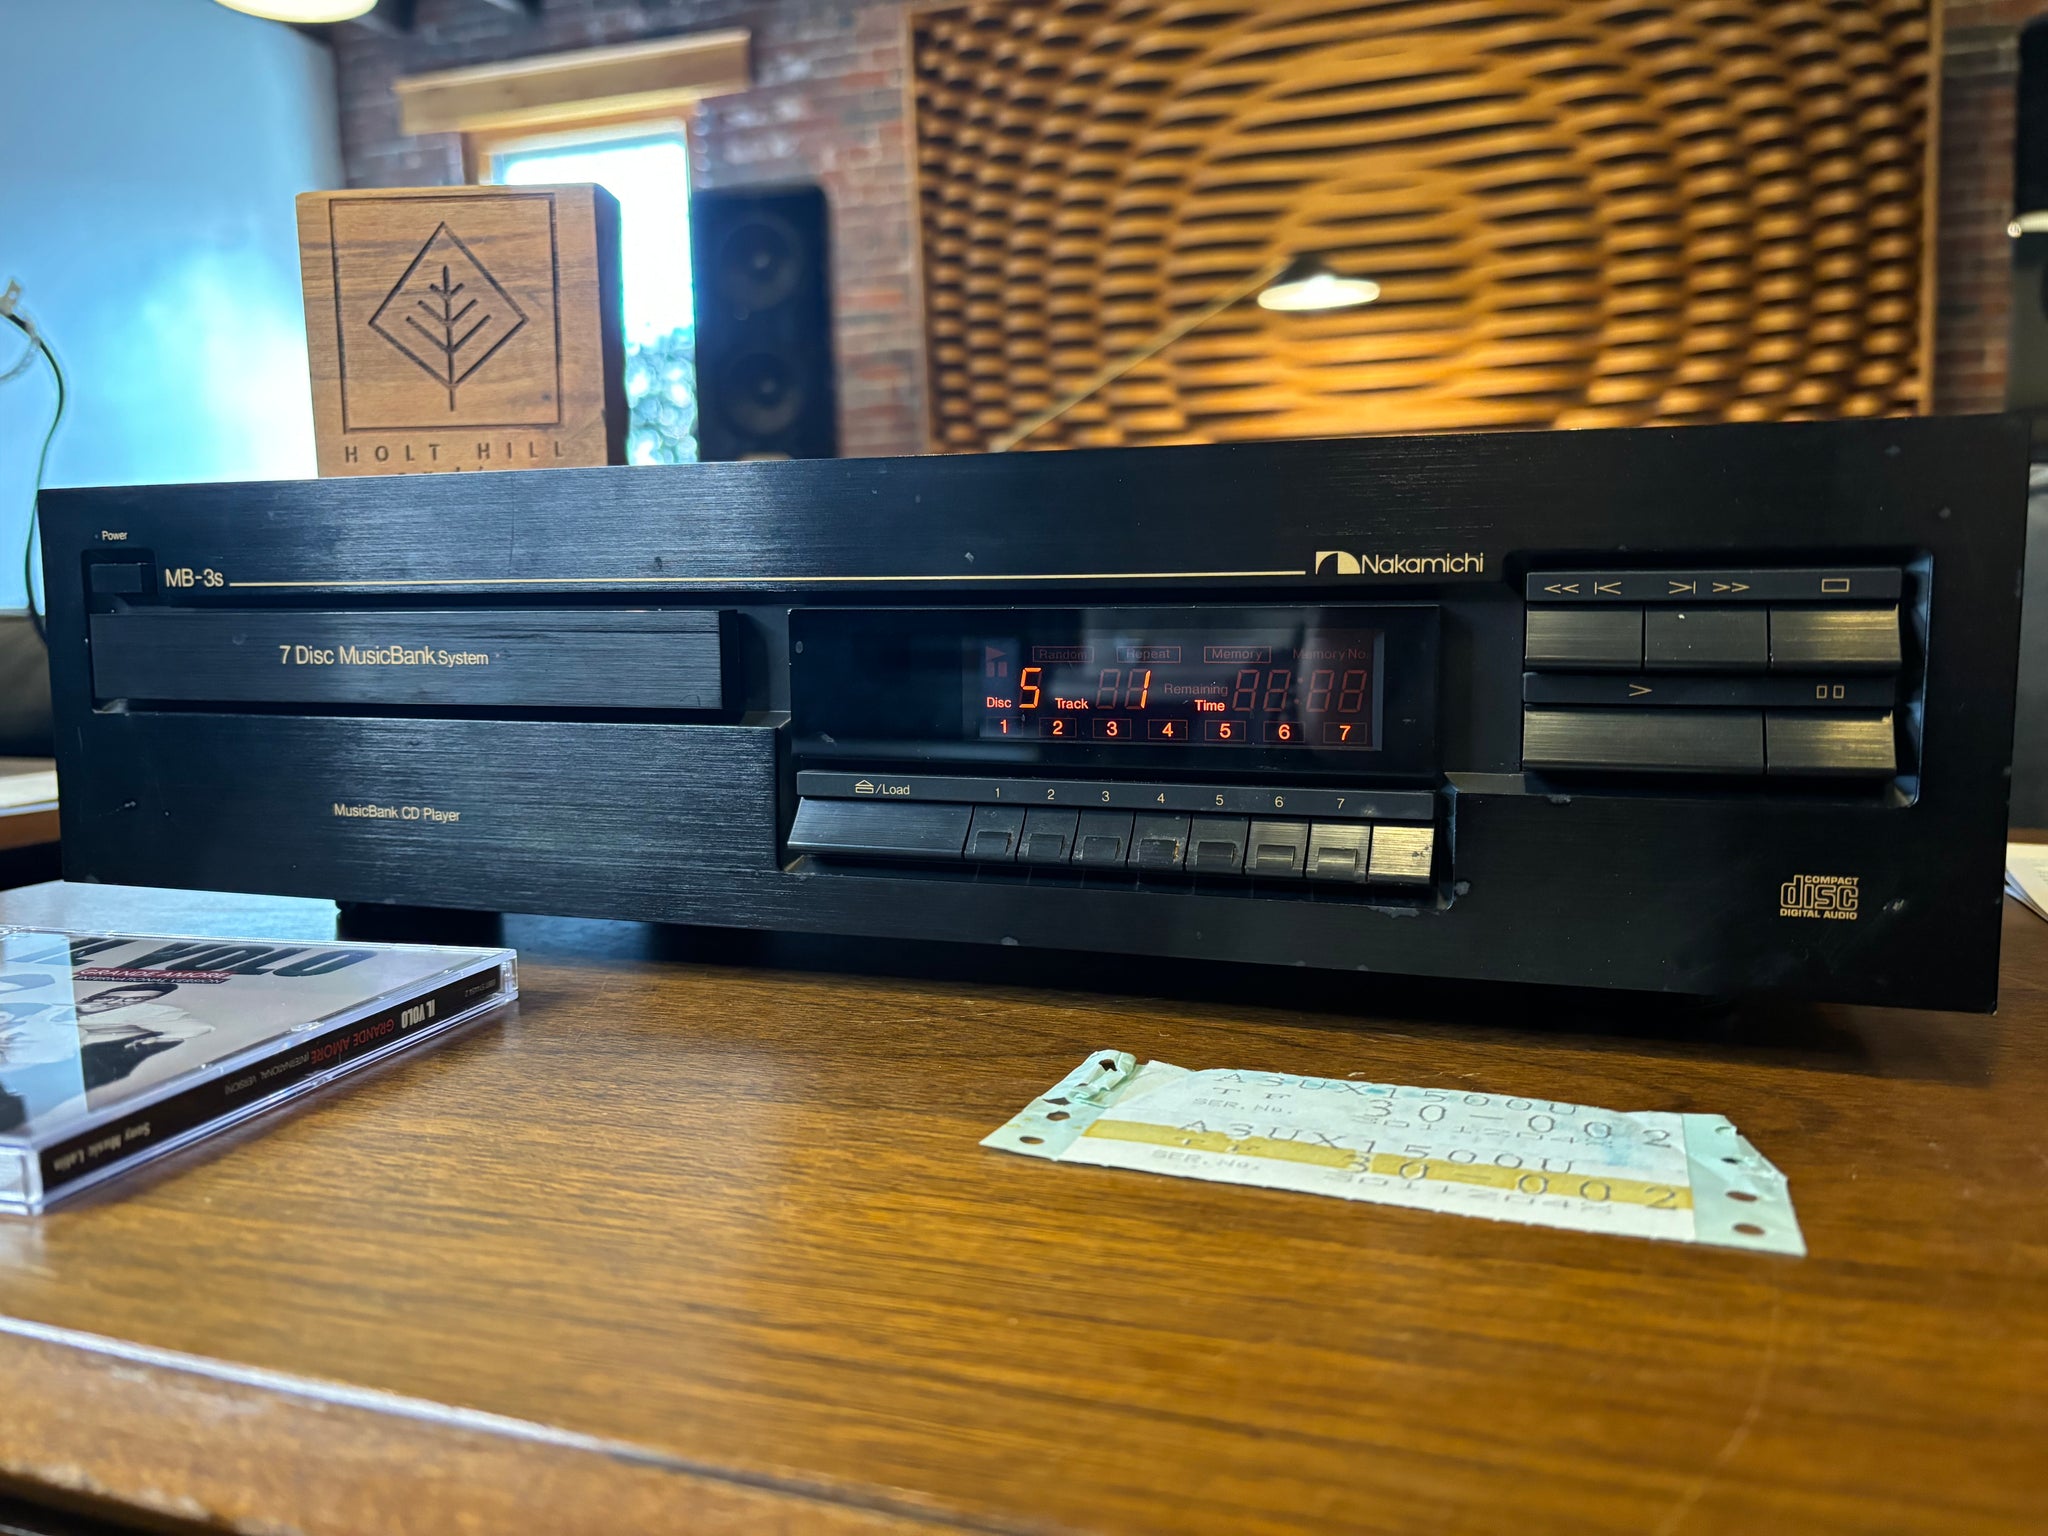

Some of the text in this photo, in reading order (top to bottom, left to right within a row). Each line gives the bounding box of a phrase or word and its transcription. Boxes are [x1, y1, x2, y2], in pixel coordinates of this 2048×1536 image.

[344, 440, 565, 464] HOLT HILL
[101, 530, 129, 542] Power
[1361, 552, 1484, 575] Nakamichi
[165, 567, 225, 588] MB-3s
[279, 645, 490, 668] 7 Disc MusicBank System
[1038, 648, 1089, 660] Random
[1125, 648, 1171, 662] Repeat
[1210, 648, 1263, 662] Memory
[1292, 648, 1346, 662] Memory
[1164, 682, 1229, 697] Remaining
[986, 696, 1012, 709] Disc
[1055, 697, 1089, 710] Track
[1194, 699, 1226, 712] Time
[1000, 719, 1008, 734] 1
[1053, 720, 1064, 735] 2
[1106, 721, 1118, 736] 3
[1162, 722, 1174, 737] 4
[1219, 723, 1232, 739] 5
[1278, 724, 1291, 740] 6
[1339, 725, 1352, 741] 7
[995, 787, 1001, 798] 1
[1047, 789, 1055, 800] 2
[1101, 790, 1110, 802] 3
[1157, 792, 1165, 804] 4
[1215, 794, 1224, 806] 5
[1274, 795, 1284, 808] 6
[1336, 797, 1345, 809] 7
[333, 803, 461, 824] MusicBank CD Player
[1804, 875, 1860, 886] COMPACT
[1780, 874, 1859, 911] disc
[1779, 908, 1858, 920] DIGITAL AUDIO
[115, 941, 378, 977] VOLO
[79, 967, 231, 980] GRANDE AMORE
[401, 1003, 426, 1029] VOLO
[426, 999, 436, 1018] IL
[353, 1018, 395, 1046] GRANDE
[310, 1037, 350, 1065] AMORE
[124, 1122, 151, 1141] Sony
[87, 1134, 122, 1158] Music
